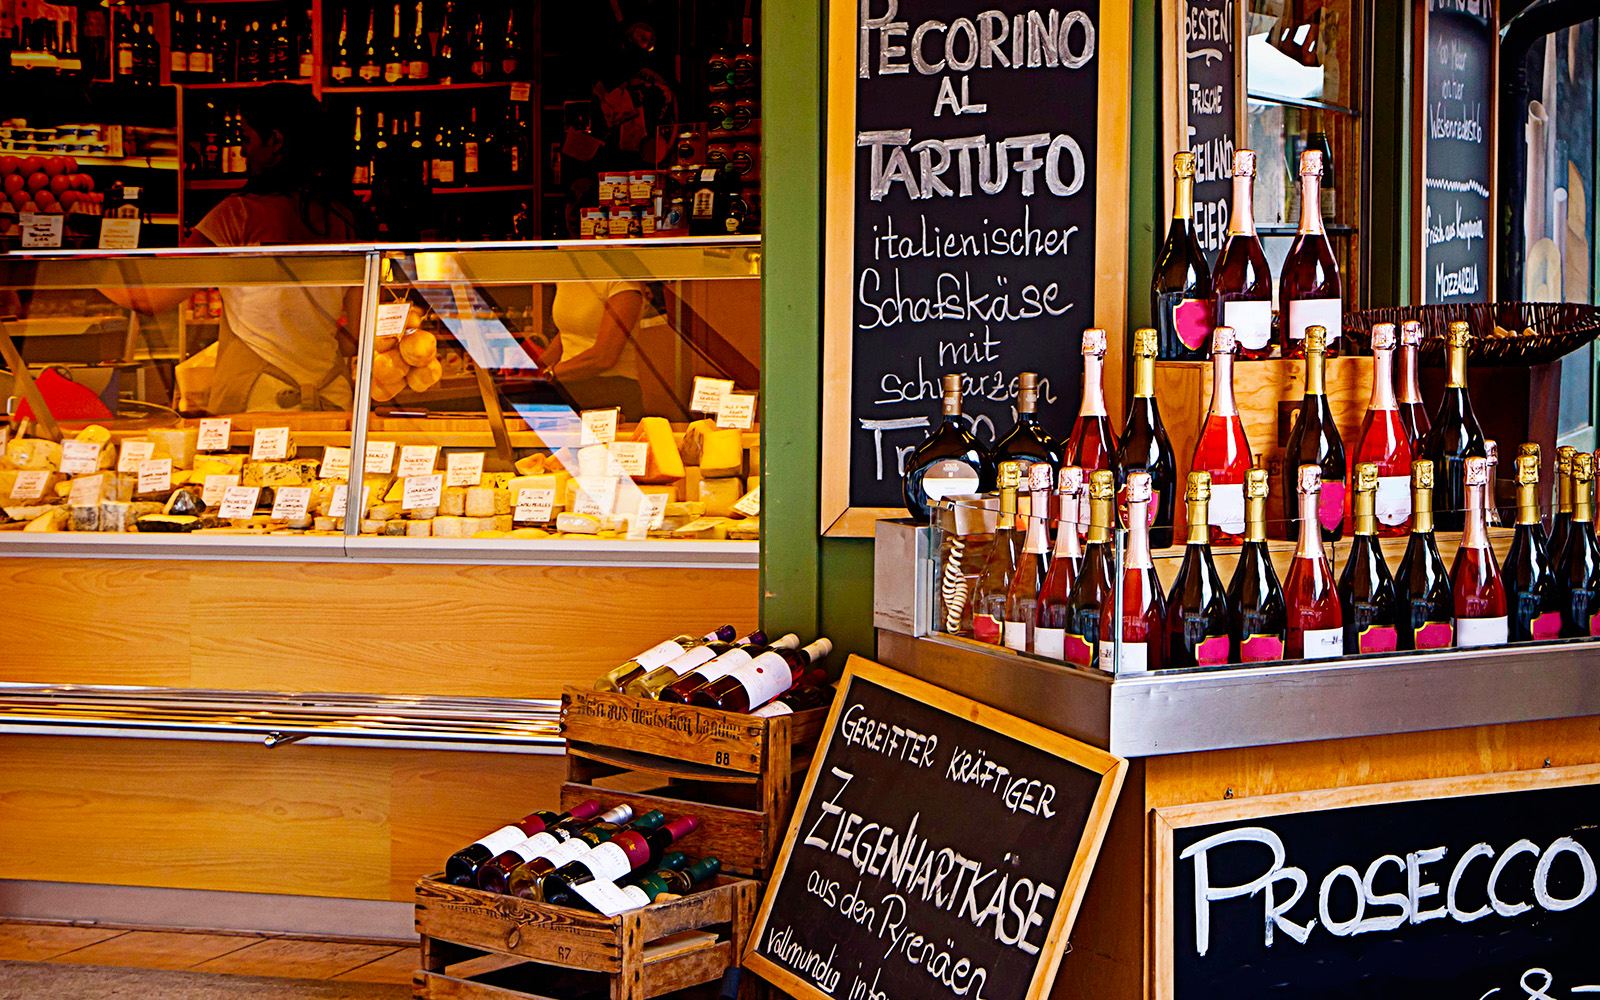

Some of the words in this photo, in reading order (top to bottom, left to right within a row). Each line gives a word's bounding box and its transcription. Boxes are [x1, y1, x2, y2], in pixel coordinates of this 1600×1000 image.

[859, 0, 1096, 79] PECORINO
[933, 75, 987, 116] AL
[1189, 83, 1223, 114] FRISCHE
[857, 128, 1085, 201] TARTUFO
[873, 204, 1079, 260] italienischer
[859, 266, 1074, 330] Schafskäse
[939, 325, 1001, 367] mit
[607, 703, 628, 722] aus
[715, 751, 730, 766] 88
[842, 703, 938, 768] GEREIFTER
[946, 745, 1056, 818] KRÄFTIGER
[804, 767, 1057, 955] ZIEGENHARTKÄSE
[1179, 826, 1598, 957] PROSECCO
[767, 925, 841, 993] vollmundig
[807, 869, 840, 908] aus
[840, 881, 876, 932] den
[878, 893, 987, 1000] Pyrenäen
